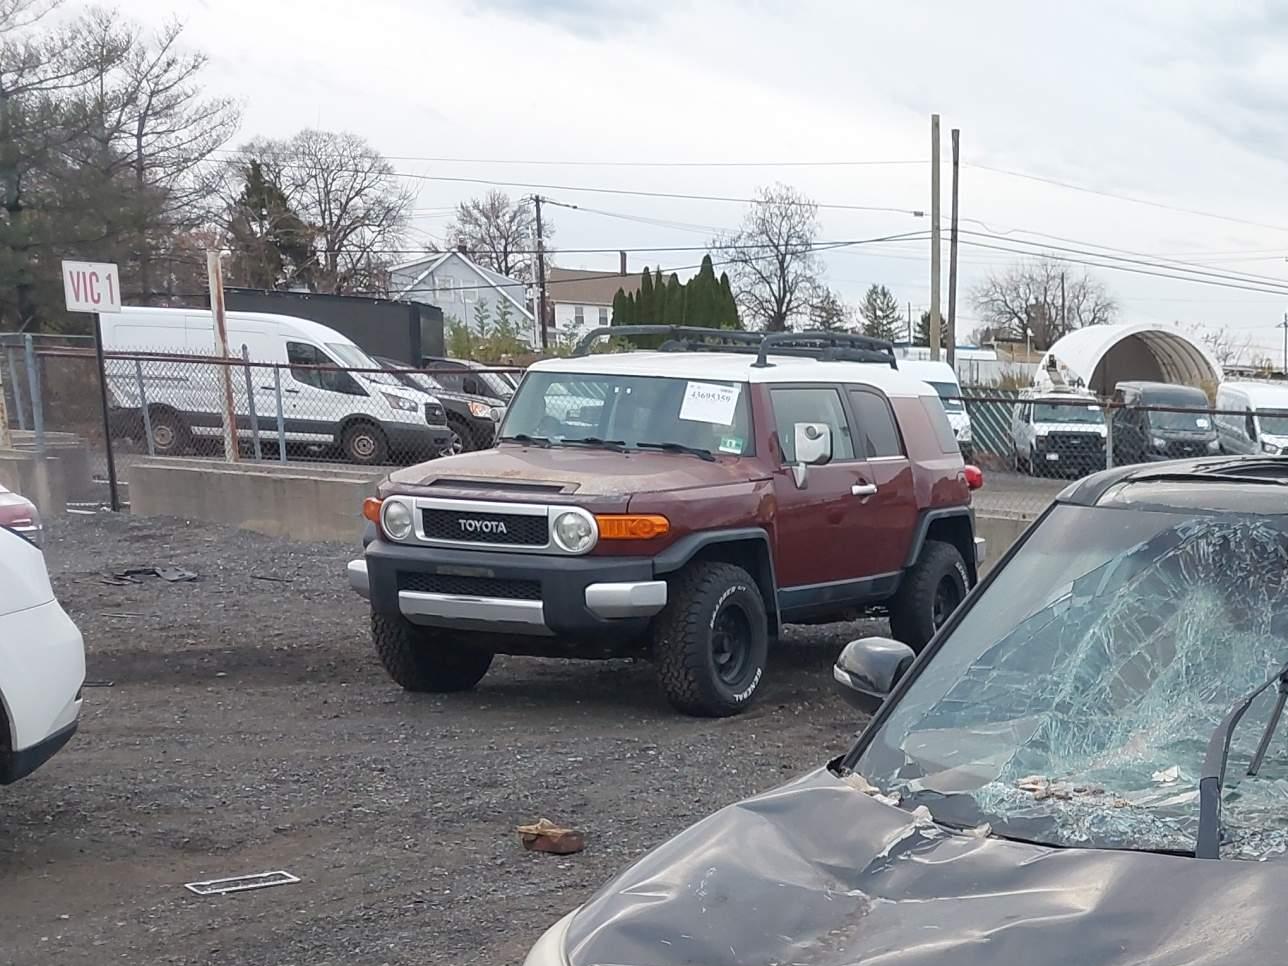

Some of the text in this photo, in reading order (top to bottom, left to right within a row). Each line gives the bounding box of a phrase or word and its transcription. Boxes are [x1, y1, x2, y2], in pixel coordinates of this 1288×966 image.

[69, 270, 114, 305] VIC 1
[458, 519, 507, 534] TOYOTA
[732, 667, 762, 702] GENERAL
